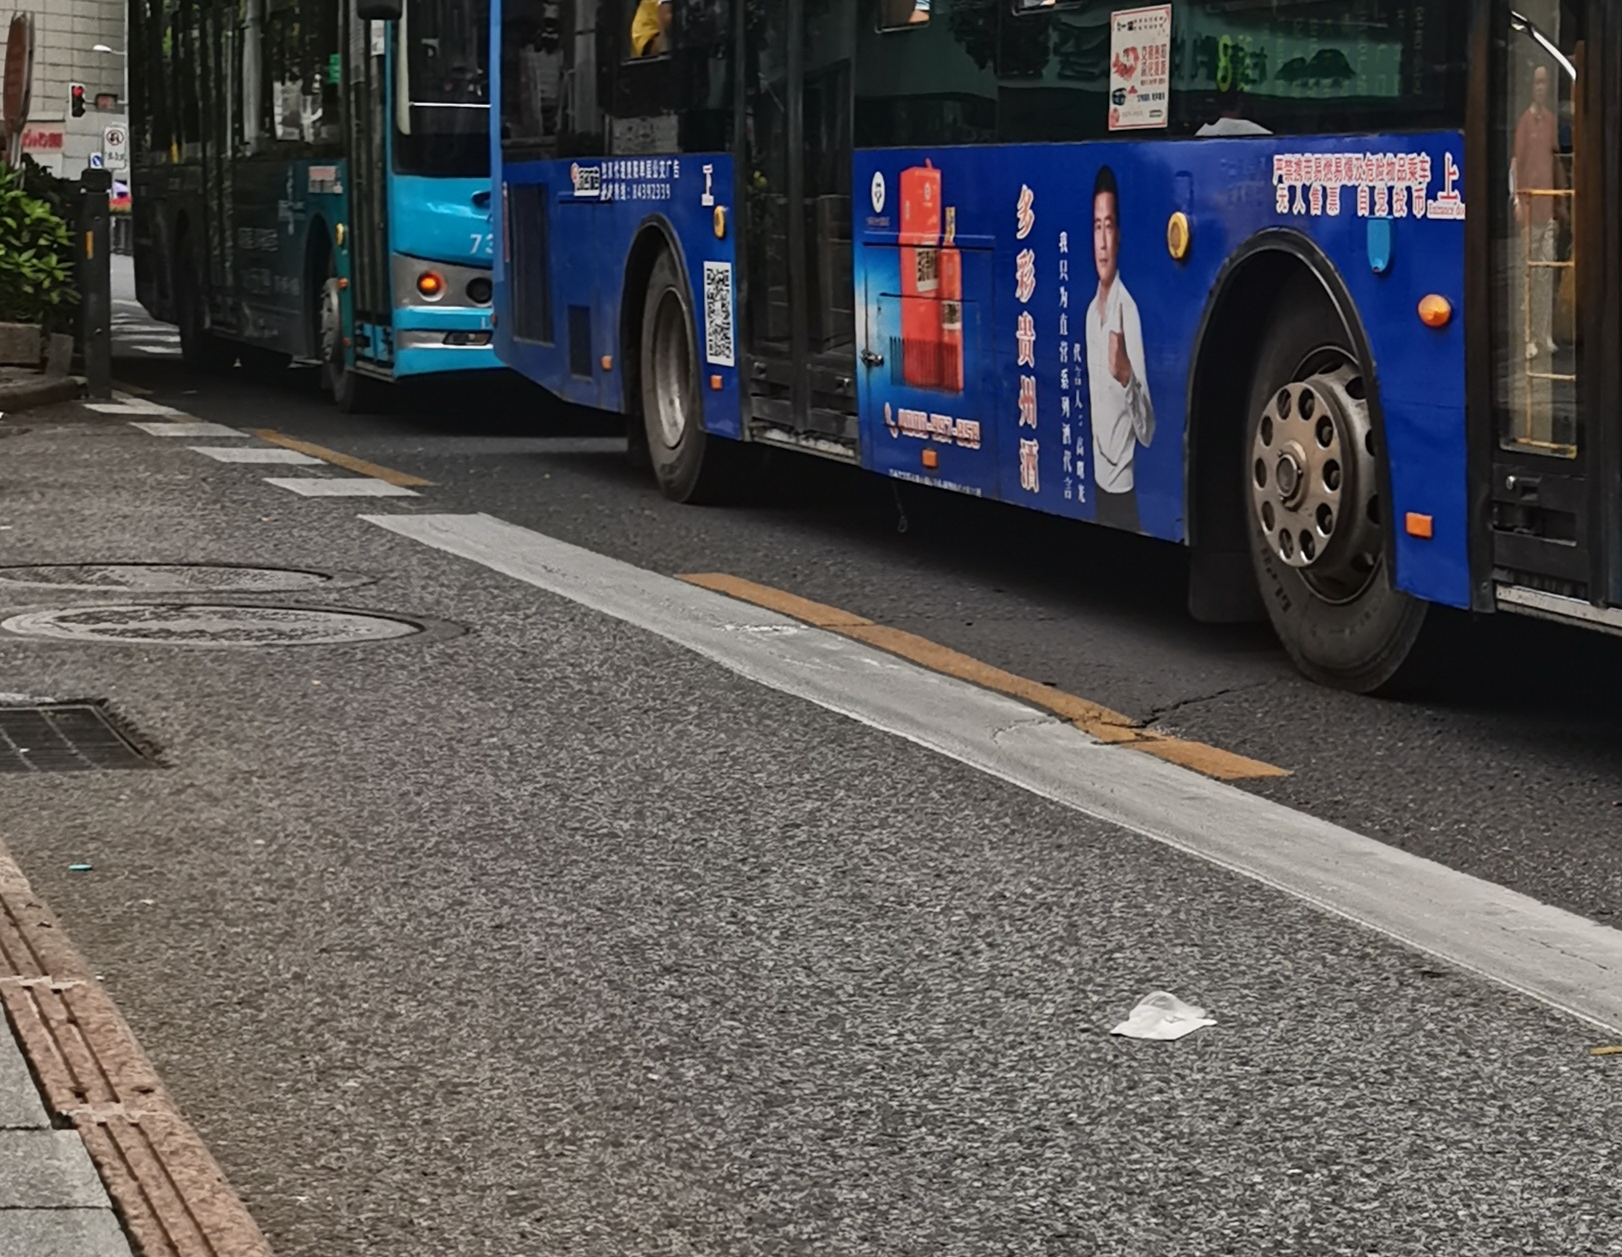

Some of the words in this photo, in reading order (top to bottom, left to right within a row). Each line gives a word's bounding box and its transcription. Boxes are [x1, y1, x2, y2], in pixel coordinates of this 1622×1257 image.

[1276, 184, 1341, 216] 无人售票
[1357, 184, 1426, 219] 自觉投币
[1014, 183, 1041, 494] 多彩贵州酒
